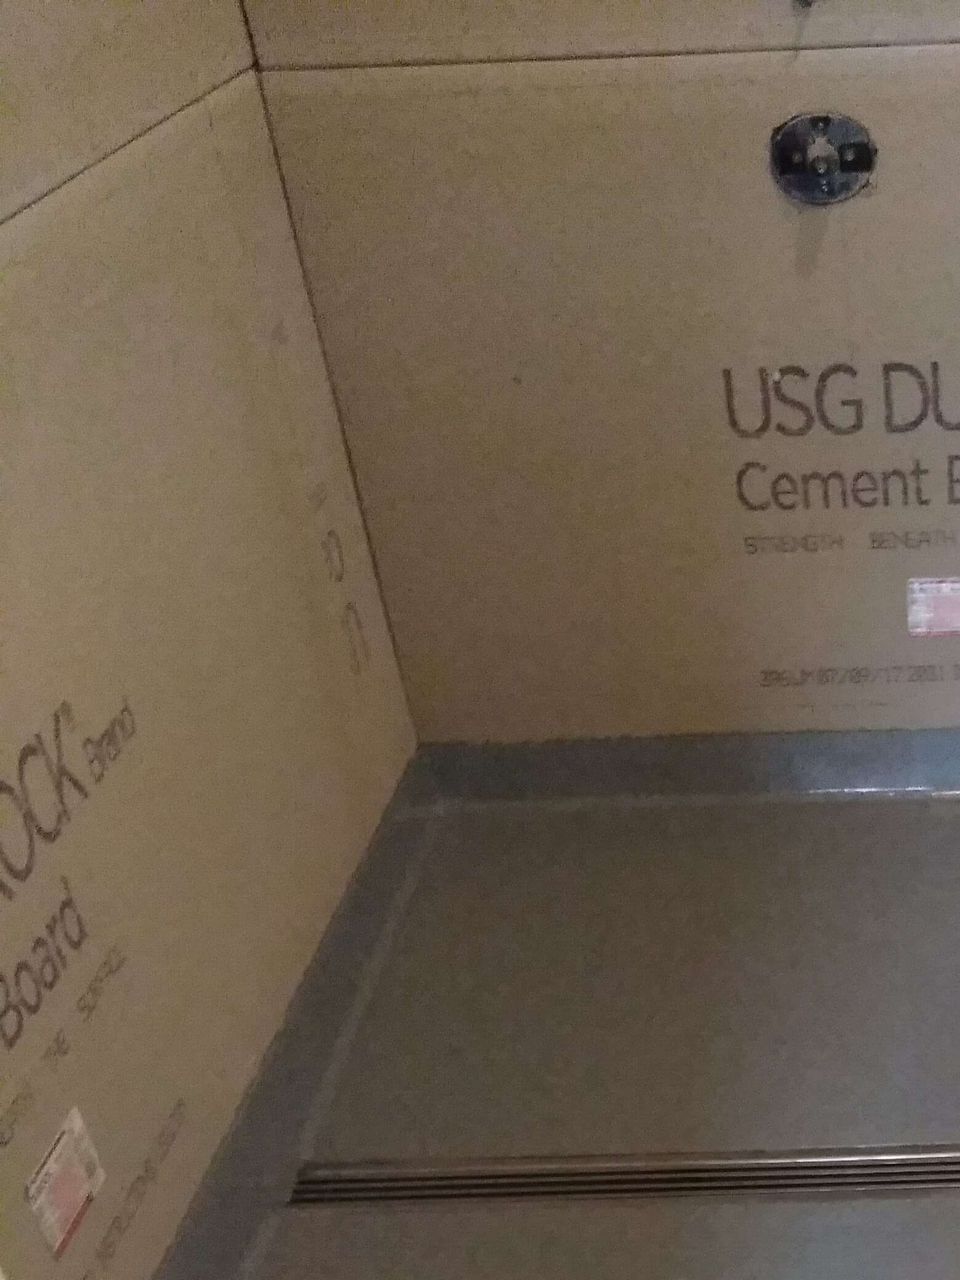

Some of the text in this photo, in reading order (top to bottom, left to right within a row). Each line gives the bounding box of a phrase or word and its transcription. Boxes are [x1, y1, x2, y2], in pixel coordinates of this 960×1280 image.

[722, 363, 864, 439] USG
[735, 459, 930, 512] Cement
[0, 697, 137, 901] OCK Brand
